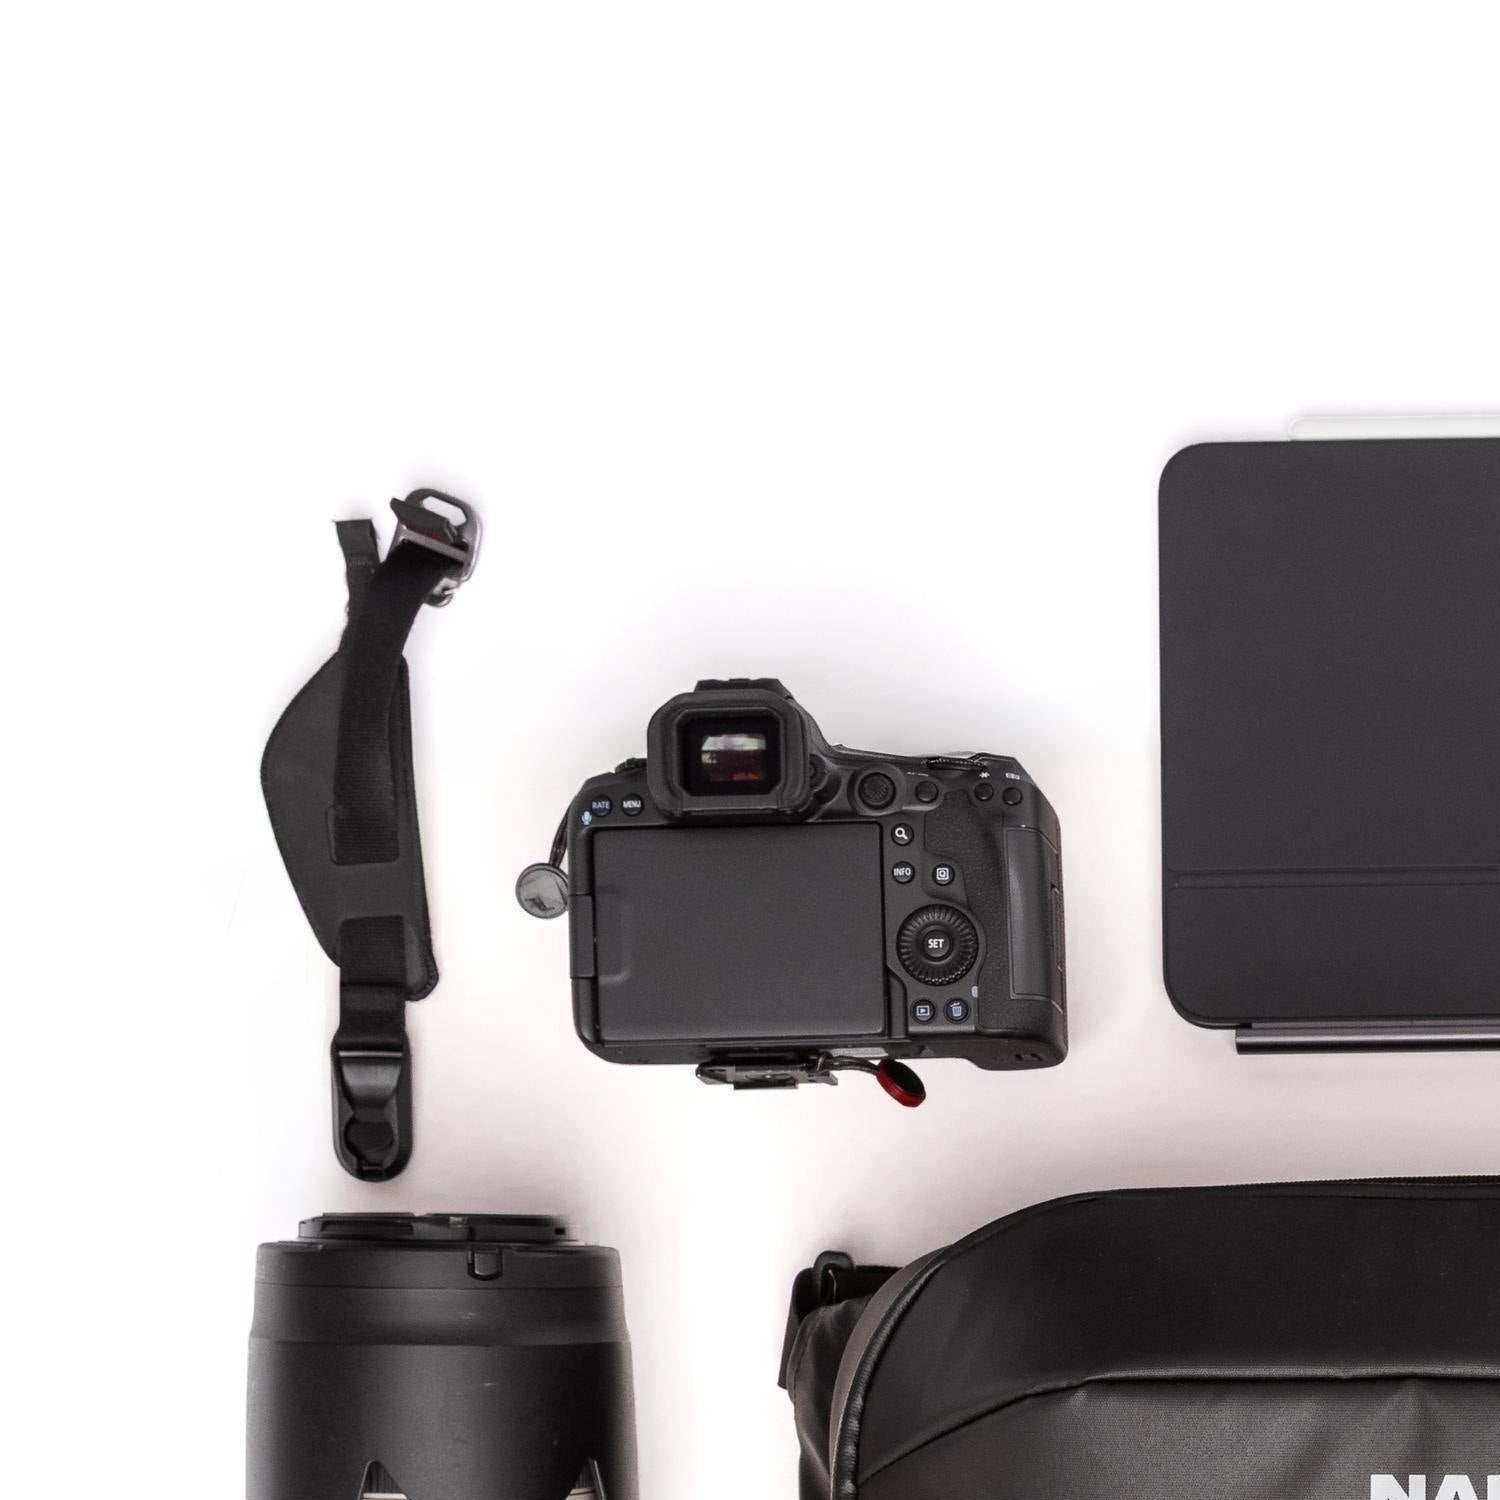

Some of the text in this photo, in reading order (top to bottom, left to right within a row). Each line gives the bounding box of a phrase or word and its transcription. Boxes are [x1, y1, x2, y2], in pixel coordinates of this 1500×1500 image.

[592, 800, 609, 809] RATE
[623, 800, 641, 808] MENU
[893, 868, 911, 876] INFO
[928, 939, 944, 948] SET
